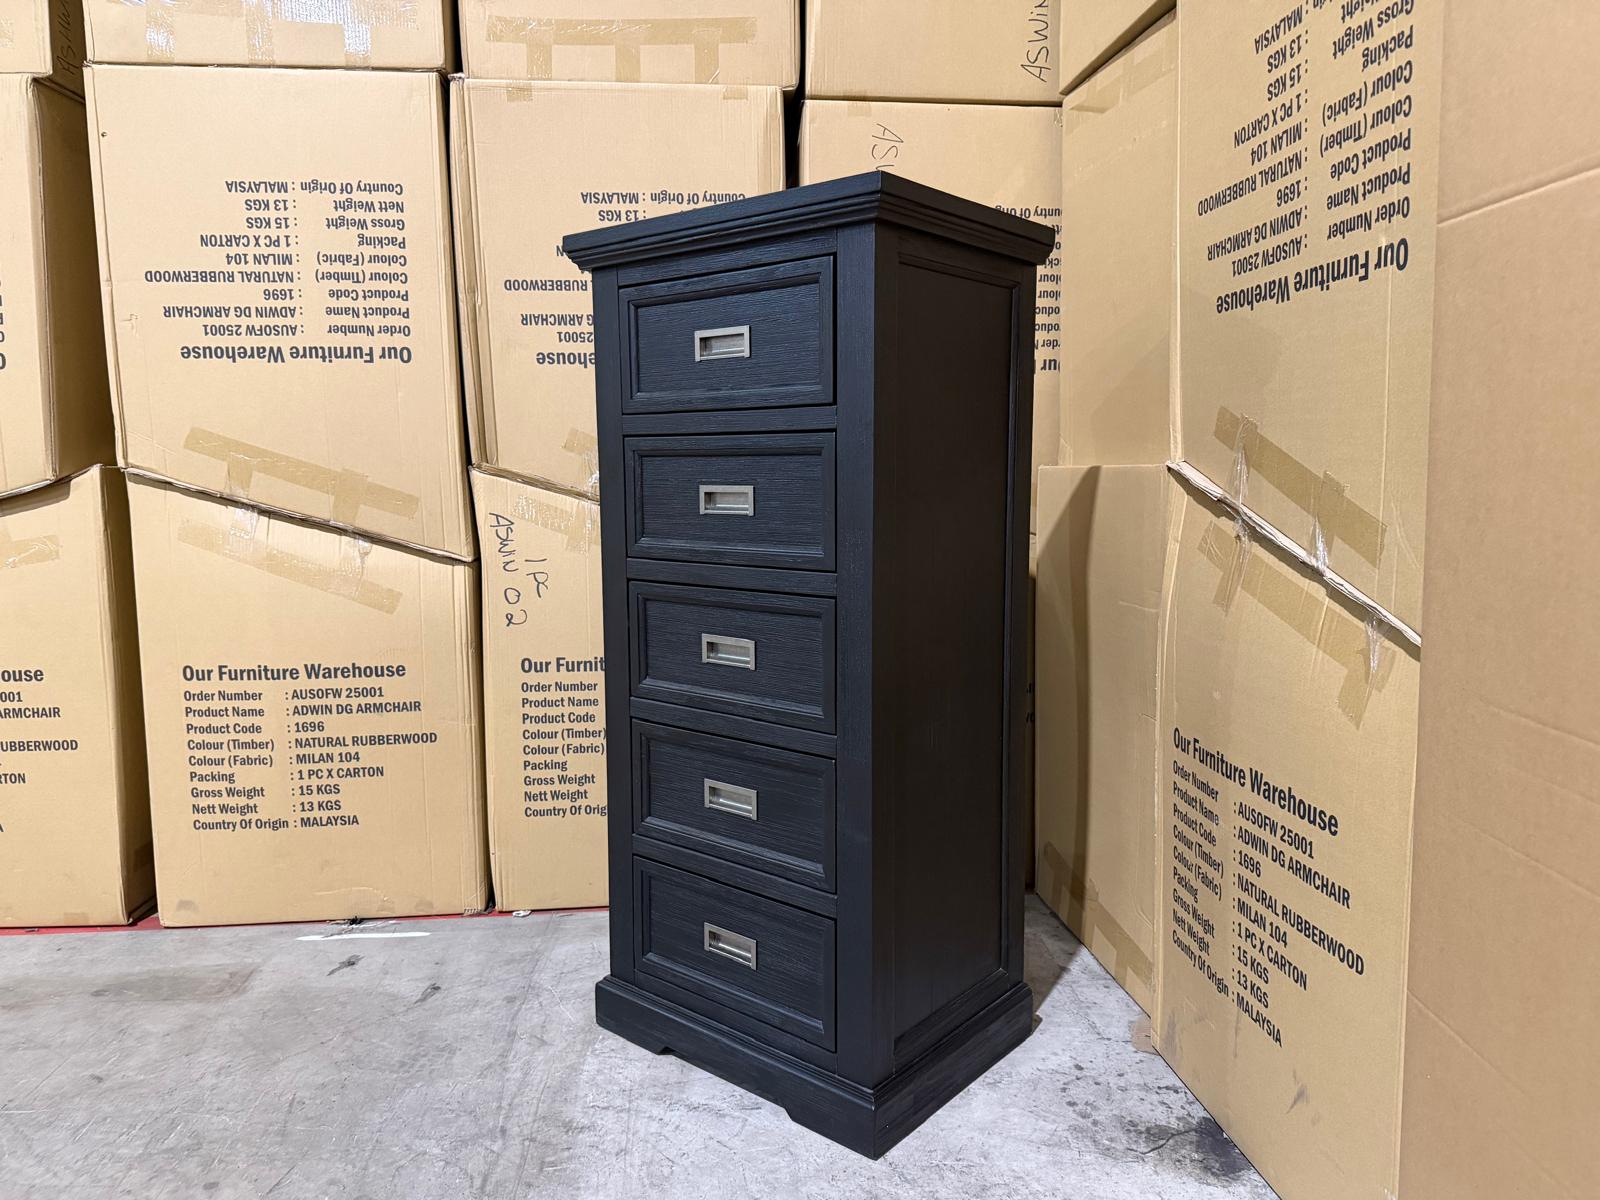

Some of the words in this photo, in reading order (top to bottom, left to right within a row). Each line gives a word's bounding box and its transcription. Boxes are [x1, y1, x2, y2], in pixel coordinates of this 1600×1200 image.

[1254, 4, 1303, 55] MALAYSIA
[1289, 33, 1302, 59] 13
[1361, 24, 1414, 73] Packing
[1267, 44, 1287, 74] KGS
[1288, 63, 1302, 89] 15
[1266, 72, 1287, 102] KGS
[1279, 97, 1293, 122] PC
[1234, 112, 1270, 149] CARTON
[1270, 121, 1302, 156] MILAN
[1250, 140, 1268, 167] 104
[1258, 149, 1302, 188] NATURAL
[224, 180, 289, 194] MALAYSIA
[300, 178, 337, 195] Origin
[339, 182, 354, 195] Of
[356, 179, 404, 196] Country
[1361, 161, 1411, 201] Product
[580, 192, 639, 205] MALAYSIA
[650, 190, 684, 205] Origin
[686, 192, 700, 205] Of
[1197, 173, 1257, 217] RUBBERWOOD
[1276, 179, 1302, 208] 1696
[1326, 183, 1359, 211] Name
[244, 198, 270, 212] KGS
[273, 199, 289, 212] 13
[332, 197, 376, 213] Weight
[377, 200, 405, 214] Nett
[1374, 195, 1411, 224] Order
[245, 216, 272, 229] KGS
[274, 216, 290, 230] 15
[325, 215, 369, 231] Weight
[598, 210, 622, 221] KGS
[625, 210, 639, 221] 13
[1269, 207, 1303, 238] ADWIN
[370, 218, 406, 231] Gross
[1326, 209, 1373, 241] Number
[200, 234, 251, 248] CARTON
[252, 234, 262, 248] X
[263, 234, 281, 248] PC
[283, 234, 291, 248] 1
[1254, 222, 1268, 244] DG
[357, 233, 406, 250] Packing
[1207, 227, 1253, 262] ARMCHAIR
[225, 253, 249, 266] 104
[252, 253, 293, 266] MILAN
[316, 251, 365, 267] (Fabric)
[1260, 235, 1303, 268] AUSOFW
[1373, 237, 1409, 272] Our
[367, 254, 408, 267] Colour
[1231, 251, 1260, 278] 25001
[144, 270, 235, 283] RUBBERWOOD
[237, 270, 294, 283] NATURAL
[315, 268, 366, 284] (Timber)
[368, 271, 409, 285] Colour
[1293, 250, 1370, 293] Furniture
[504, 279, 588, 291] RUBBERWOOD
[263, 288, 295, 301] 1696
[328, 288, 360, 302] Code
[361, 289, 409, 302] Product
[1216, 275, 1291, 314] Warehouse
[162, 305, 231, 318] ARMCHAIR
[233, 305, 252, 319] DG
[254, 306, 297, 318] ADWIN
[325, 306, 361, 319] Name
[362, 306, 410, 319] Product
[520, 313, 584, 326] ARMCHAIR
[202, 324, 243, 337] 25001
[245, 324, 298, 337] AUSOFW
[327, 324, 375, 337] Number
[377, 324, 411, 338] Order
[557, 331, 594, 343] 25001
[180, 345, 286, 364] Warehouse
[289, 345, 375, 364] Furniture
[378, 346, 412, 364] Our
[182, 665, 214, 682] Our
[217, 664, 300, 682] Furniture
[303, 662, 407, 680] Warehouse
[520, 657, 553, 675] Our
[183, 690, 216, 702] Order
[217, 689, 263, 702] Number
[291, 687, 343, 700] AUSOFW
[345, 686, 385, 699] 25001
[520, 681, 553, 693] Order
[554, 680, 599, 692] Number
[184, 706, 230, 718] Product
[231, 706, 265, 718] Name
[292, 703, 333, 716] ADWIN
[335, 703, 354, 715] DG
[355, 700, 422, 714] ARMCHAIR
[521, 696, 566, 709] Product
[567, 696, 599, 708] Name
[186, 723, 232, 735] Product
[232, 722, 262, 734] Code
[294, 720, 325, 733] 1696
[522, 728, 559, 740] Colour
[0, 740, 79, 752] UBBERWOOD
[187, 739, 225, 751] Colour
[226, 738, 275, 753] (Timber)
[294, 735, 350, 749] NATURAL
[351, 732, 438, 747] RUBBERWOOD
[188, 755, 226, 767] Colour
[227, 754, 274, 769] (Fabric)
[295, 752, 334, 765] MILAN
[338, 751, 361, 763] 104
[523, 759, 568, 772] Packing
[189, 771, 236, 785] Packing
[297, 769, 305, 781] 1
[307, 768, 324, 780] PC
[326, 768, 334, 780] X
[336, 766, 384, 779] CARTON
[523, 775, 556, 787] Gross
[1173, 727, 1192, 756] Our
[1192, 737, 1247, 788] Furniture
[1249, 767, 1339, 837] Warehouse
[190, 787, 223, 799] Gross
[224, 786, 266, 800] Weight
[298, 784, 314, 796] 15
[316, 783, 341, 796] KGS
[192, 803, 217, 815] Nett
[217, 803, 259, 817] Weight
[299, 800, 315, 813] 13
[317, 799, 342, 812] KGS
[192, 819, 238, 833] Country
[239, 818, 253, 830] Of
[254, 817, 289, 832] Origin
[300, 814, 360, 828] MALAYSIA
[1237, 801, 1279, 838] AUSOFW
[1279, 824, 1315, 860] 25001
[1237, 825, 1269, 859] ADWIN
[1271, 844, 1286, 869] DG
[1287, 855, 1351, 910] ARMCHAIR
[1238, 849, 1262, 878] 1696
[1237, 897, 1267, 933] MILAN
[1268, 921, 1288, 949] 104
[1237, 872, 1280, 918] NATURAL
[1281, 903, 1365, 976] RUBBERWOOD
[1237, 945, 1249, 967] 15
[1250, 955, 1269, 985] KGS
[1244, 926, 1258, 950] PC
[1266, 944, 1307, 992] CARTON
[1236, 969, 1248, 991] 13
[1249, 980, 1269, 1009] KGS
[1236, 991, 1283, 1048] MALAYSIA
